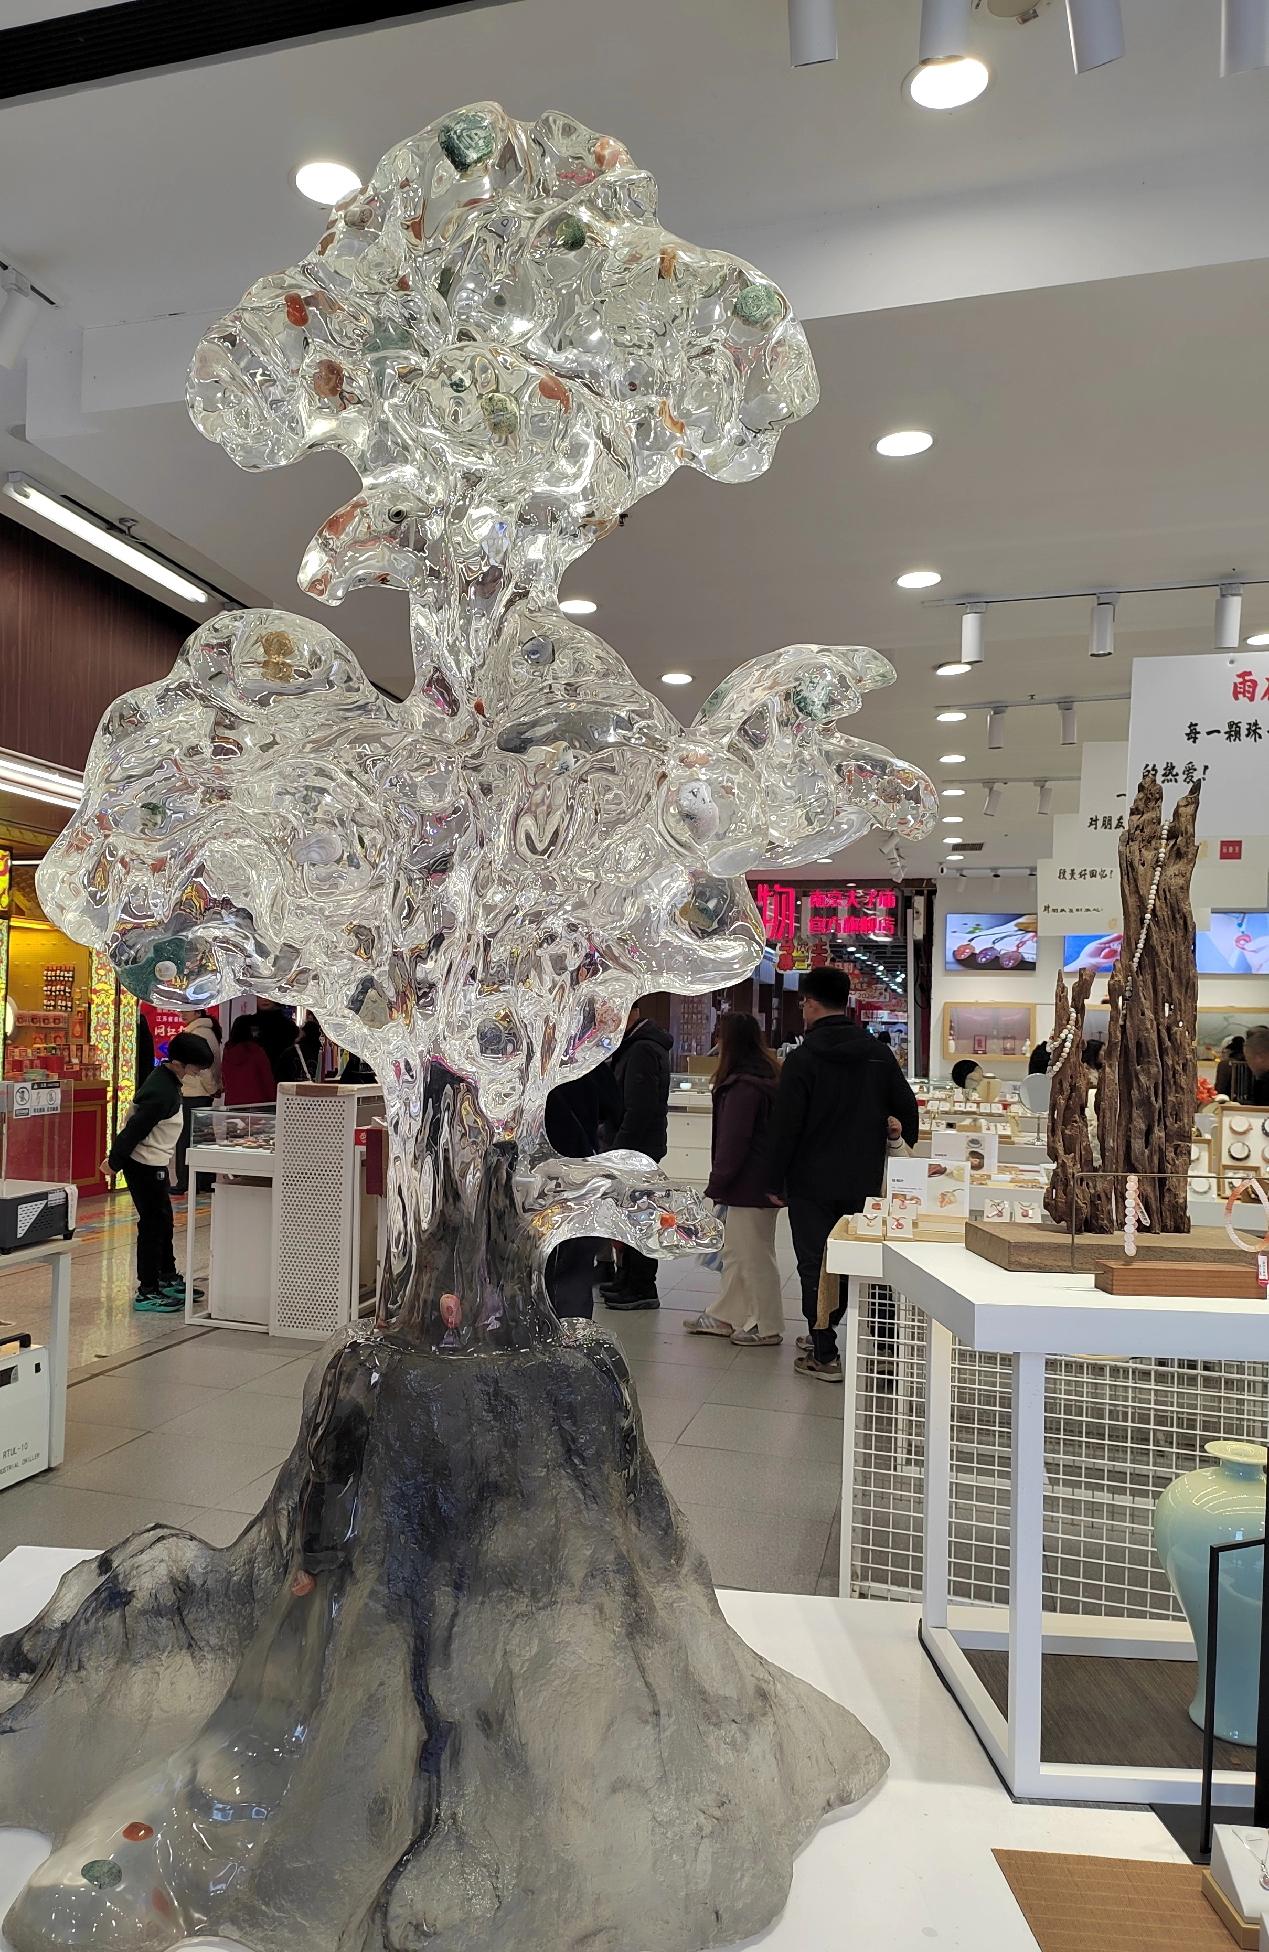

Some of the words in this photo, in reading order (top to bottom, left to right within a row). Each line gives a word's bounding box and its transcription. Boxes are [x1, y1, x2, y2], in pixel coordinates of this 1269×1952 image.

[1232, 671, 1269, 702] 雨
[1185, 719, 1269, 744] 每一颗珠
